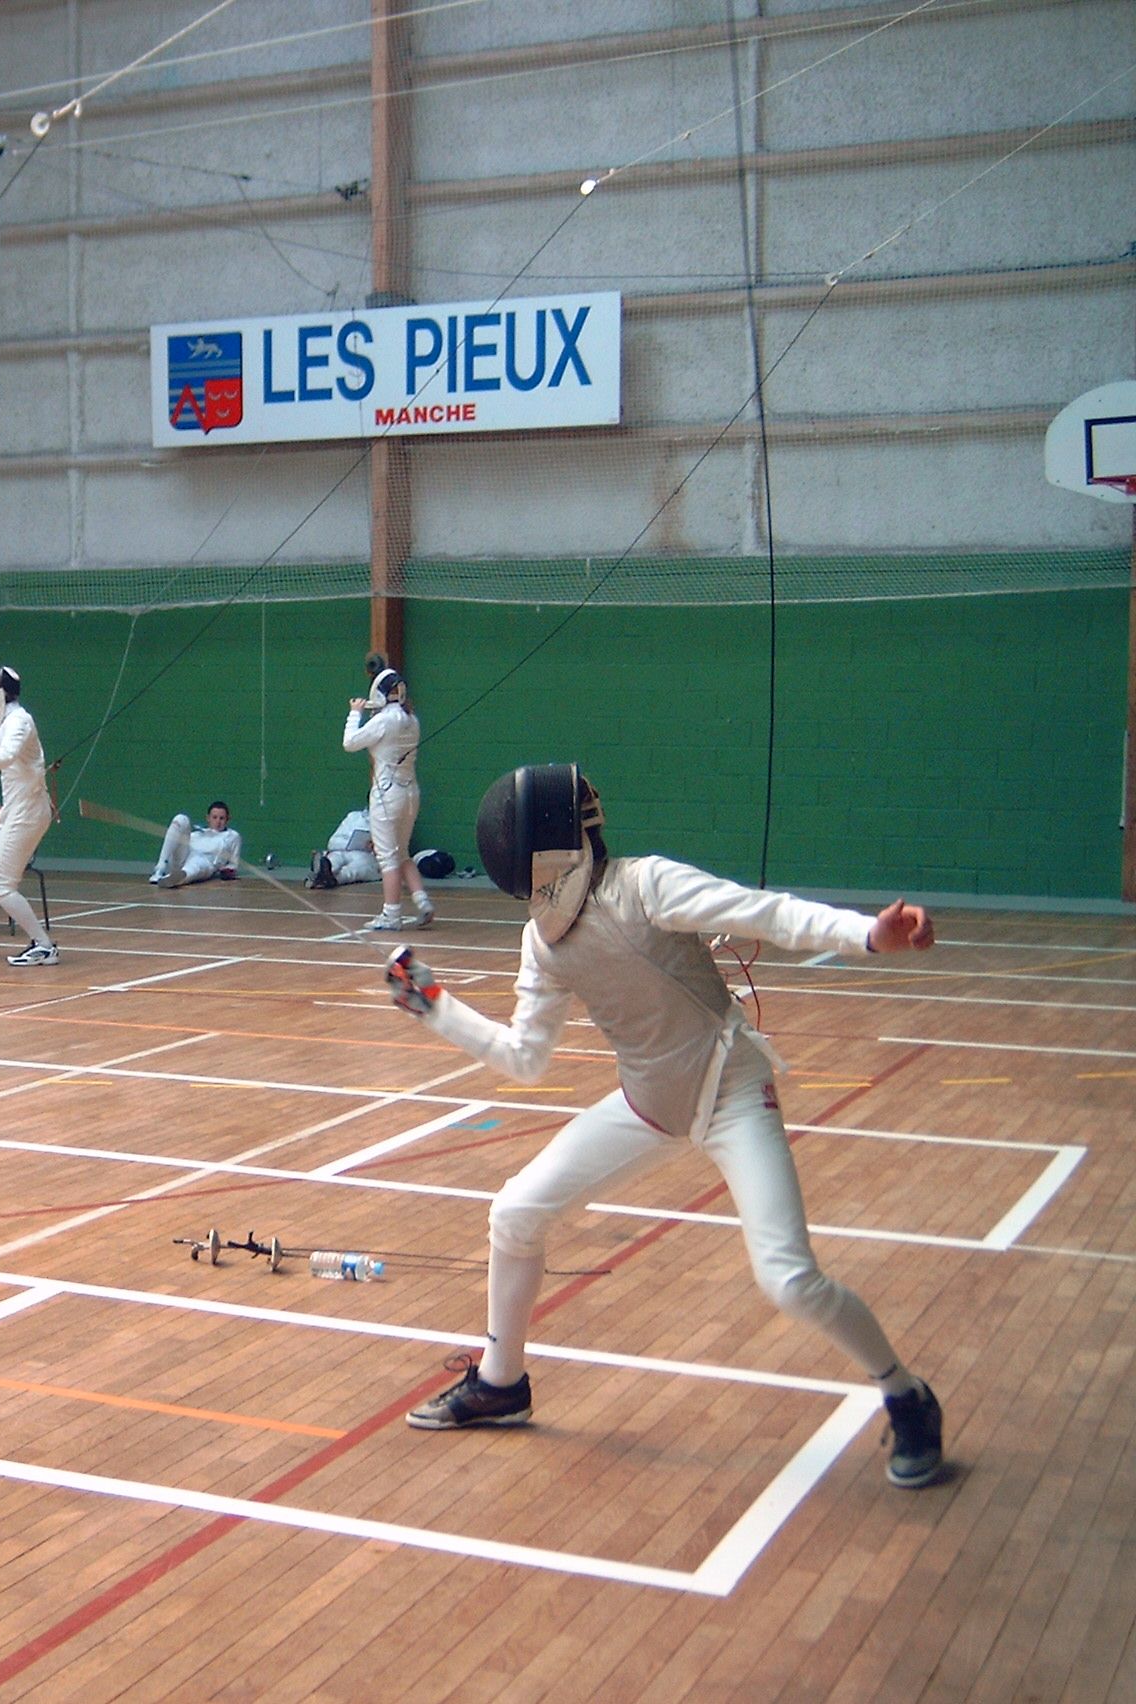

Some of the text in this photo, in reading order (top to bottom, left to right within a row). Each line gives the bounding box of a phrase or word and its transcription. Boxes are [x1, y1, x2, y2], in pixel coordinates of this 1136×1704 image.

[263, 306, 592, 404] LES PIEUX
[375, 404, 476, 426] MANCHE
